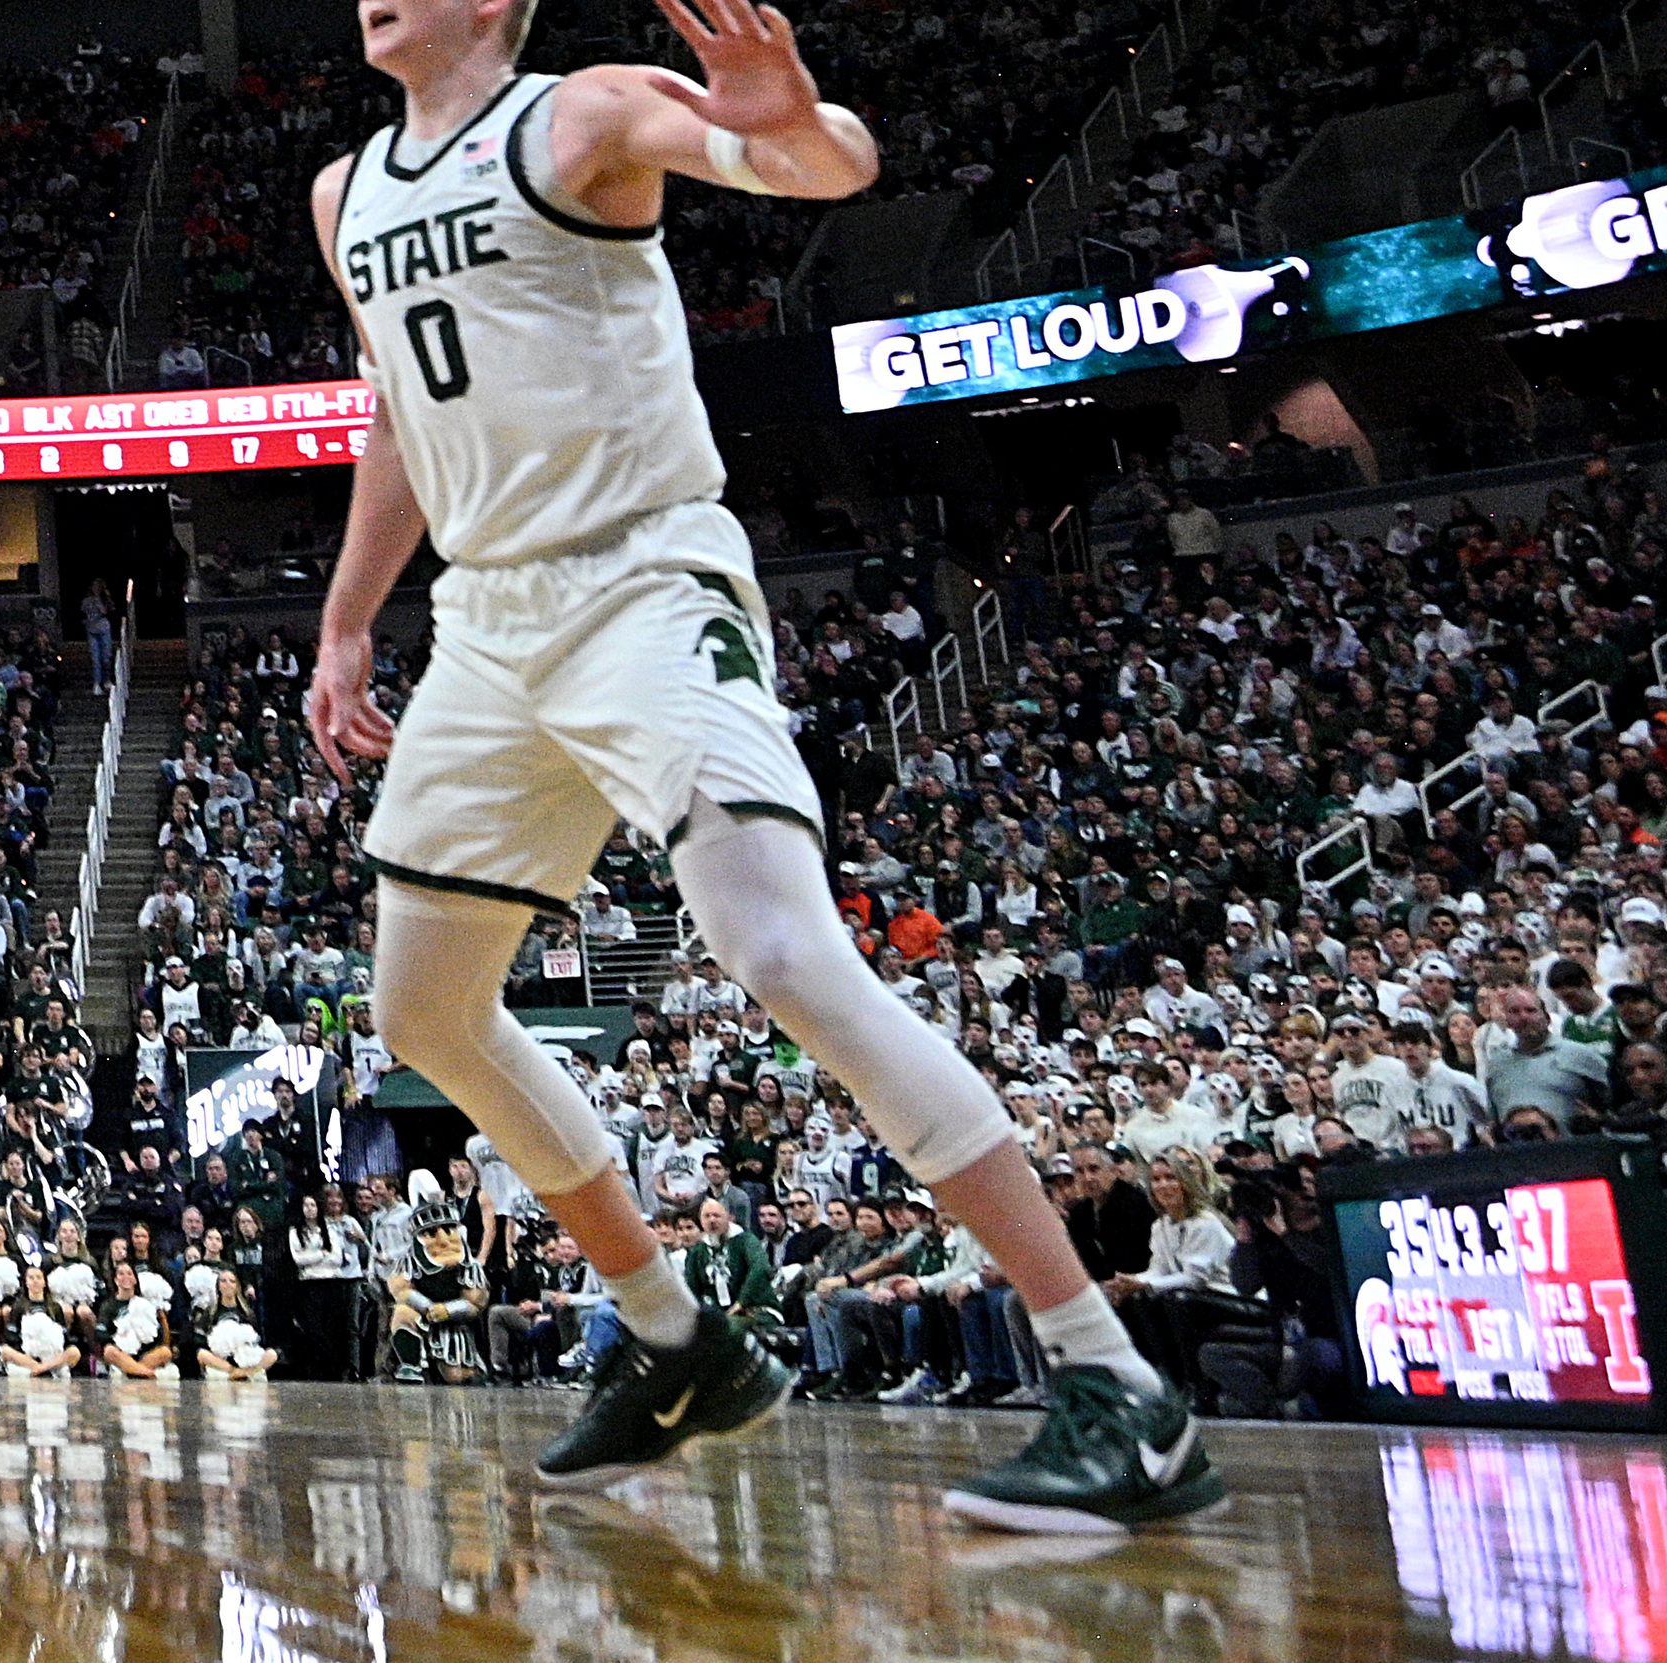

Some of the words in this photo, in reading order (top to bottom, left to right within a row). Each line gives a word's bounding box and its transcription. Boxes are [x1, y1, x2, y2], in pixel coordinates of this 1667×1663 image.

[347, 196, 511, 304] STATE
[403, 298, 470, 402] 0
[869, 322, 998, 392] GET
[1008, 288, 1185, 372] LOUD
[23, 405, 75, 433] BLK
[84, 402, 136, 430] AST
[1380, 1199, 1435, 1278] 35
[1510, 1188, 1567, 1274] 37
[1467, 1308, 1515, 1361] 1ST
